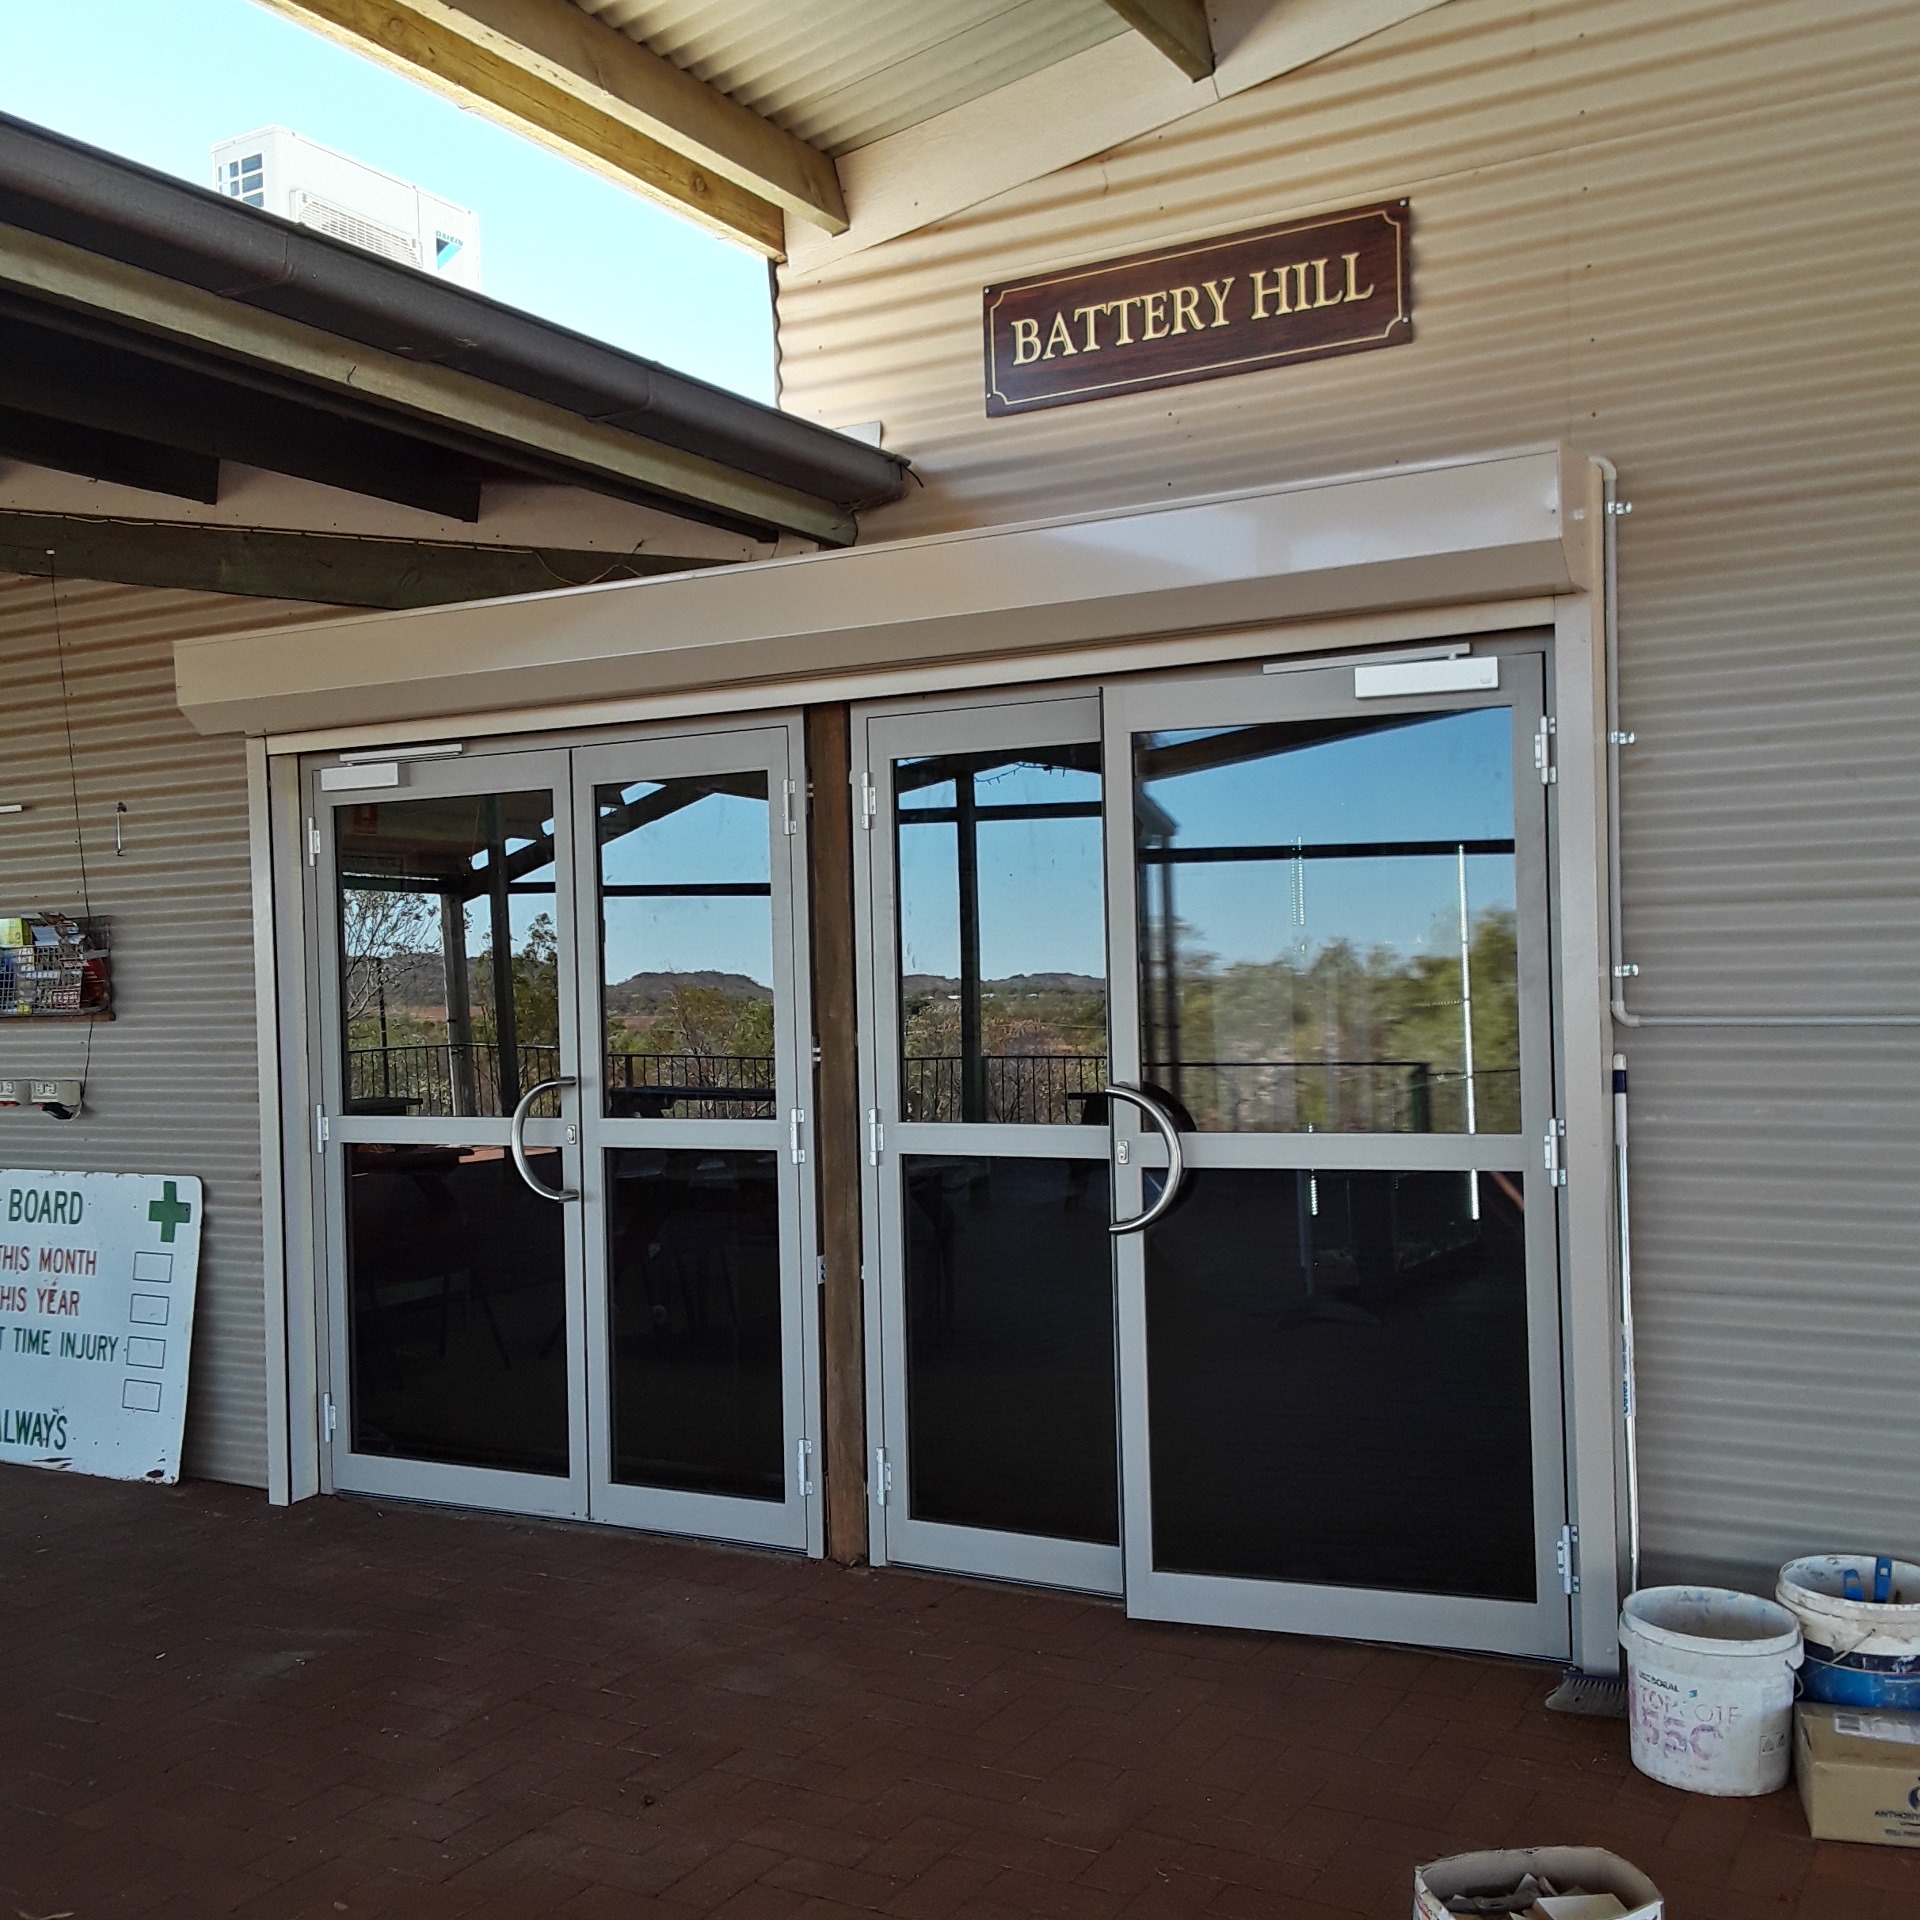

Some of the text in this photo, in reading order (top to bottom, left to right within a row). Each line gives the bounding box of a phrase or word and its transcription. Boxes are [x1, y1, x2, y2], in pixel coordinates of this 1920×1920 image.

[436, 229, 464, 247] DAIKIN
[1010, 251, 1375, 367] BATTERY HILL
[8, 1188, 84, 1225] BOARD
[38, 1247, 98, 1276] MONTH
[36, 1288, 81, 1316] YEAR
[13, 1327, 51, 1356] TIME
[59, 1331, 119, 1362] INJURY
[0, 1408, 69, 1451] LWAYS
